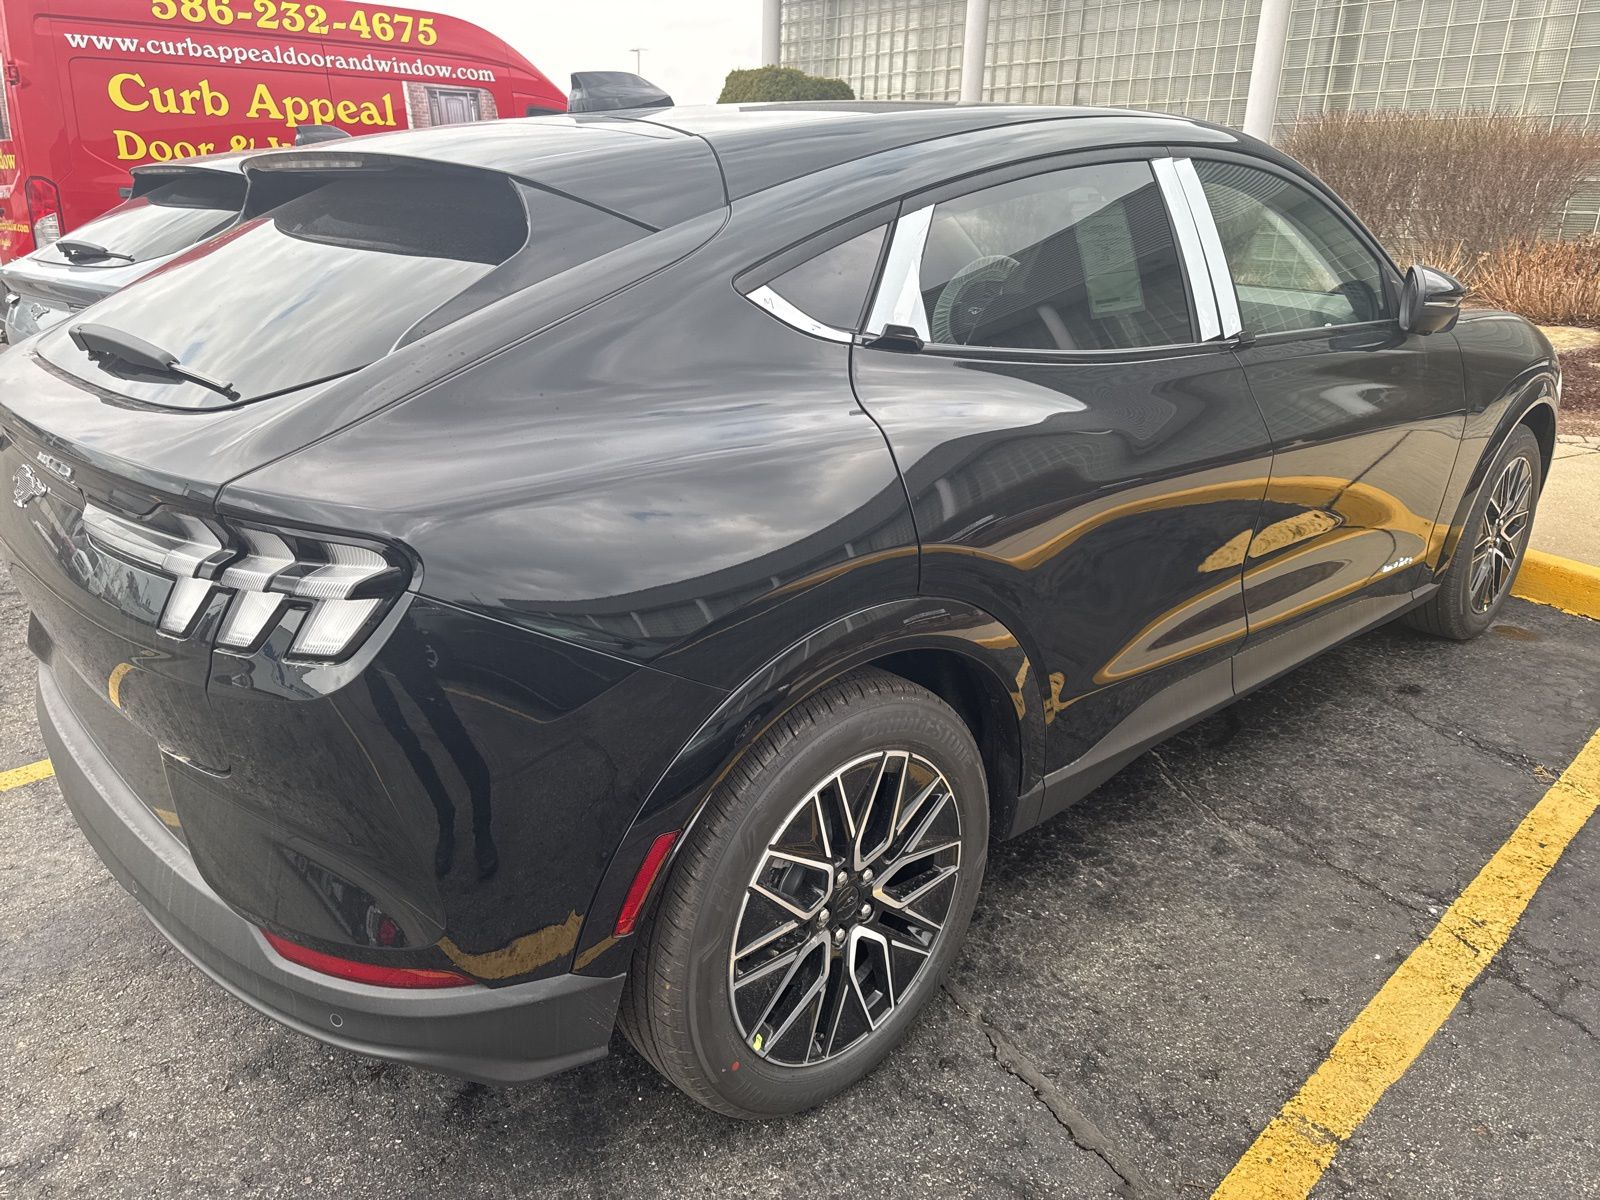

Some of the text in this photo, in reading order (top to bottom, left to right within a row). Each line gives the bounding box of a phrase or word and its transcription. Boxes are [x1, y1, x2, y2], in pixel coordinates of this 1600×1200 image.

[150, 0, 438, 46] 586-232-4675
[64, 33, 496, 82] www.curbappealdoorandwindow.com
[107, 73, 397, 128] Curb Appeal
[113, 129, 215, 162] Door
